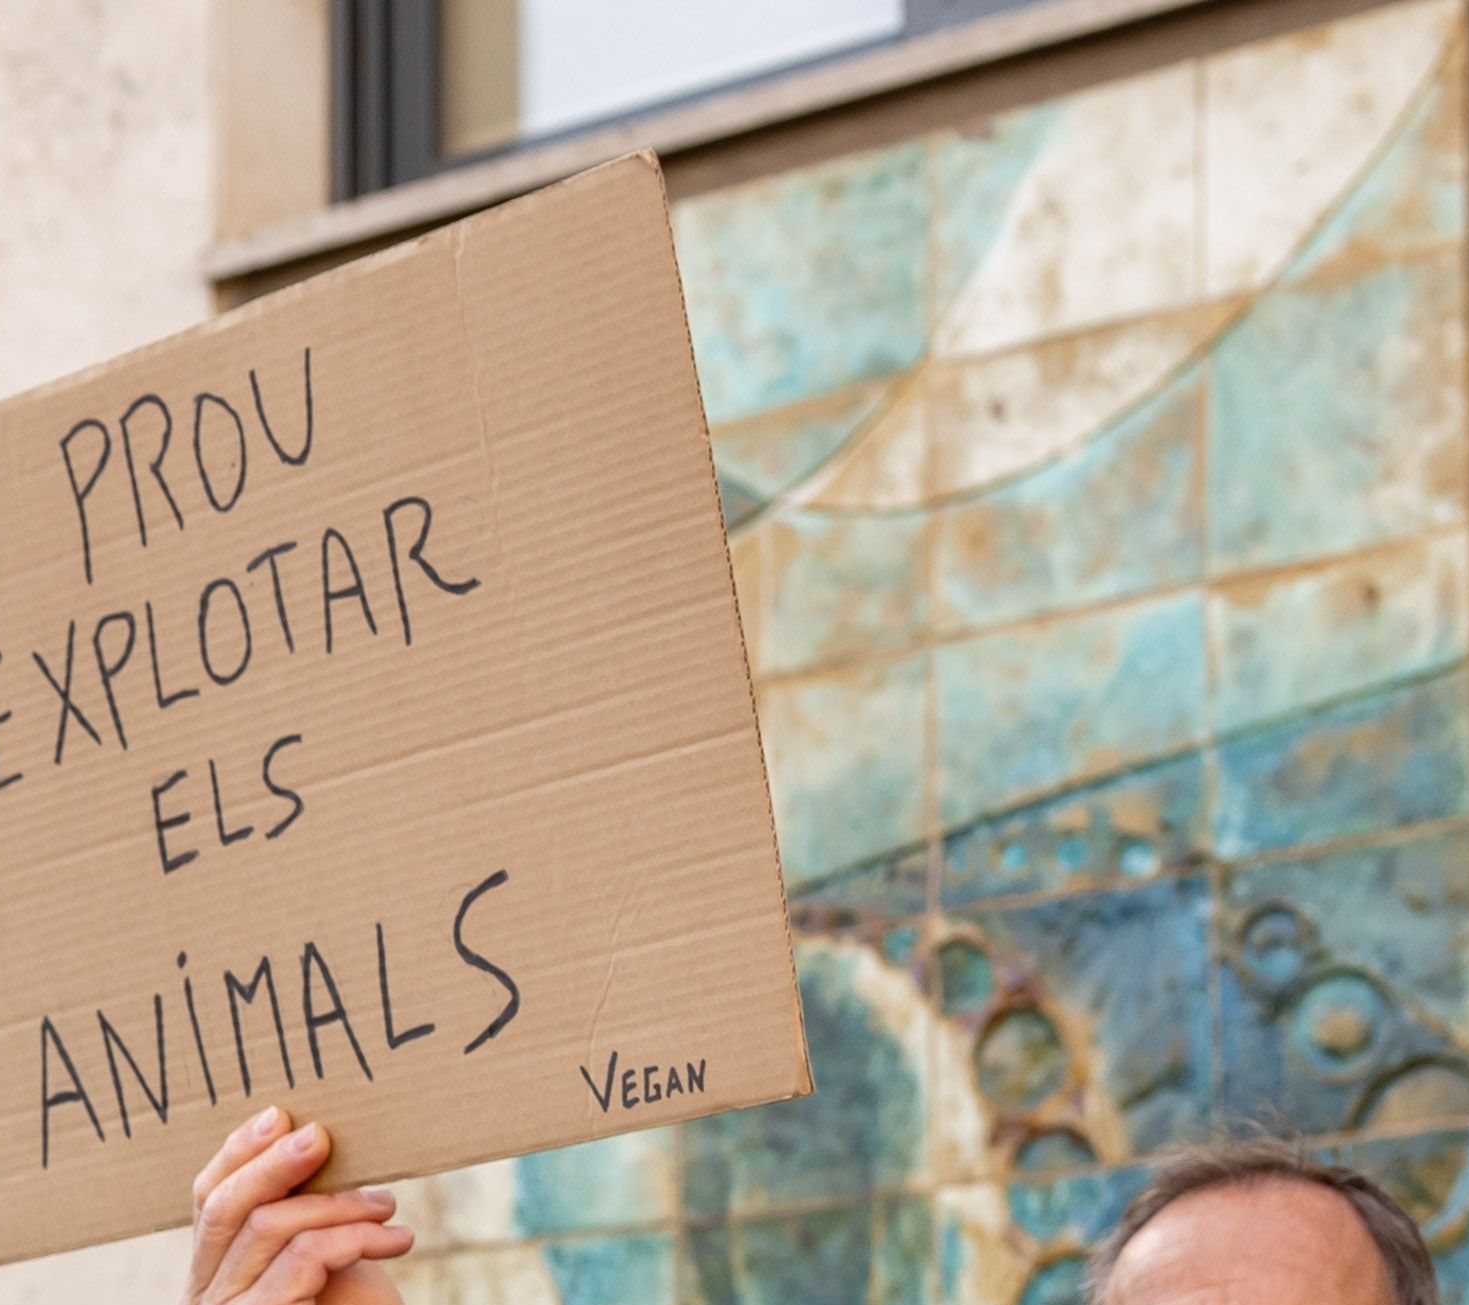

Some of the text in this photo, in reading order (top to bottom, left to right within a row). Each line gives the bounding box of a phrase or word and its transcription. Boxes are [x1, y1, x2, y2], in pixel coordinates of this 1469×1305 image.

[58, 346, 313, 586] PROU
[150, 732, 306, 874] ELS
[578, 1050, 708, 1112] VEGAN
